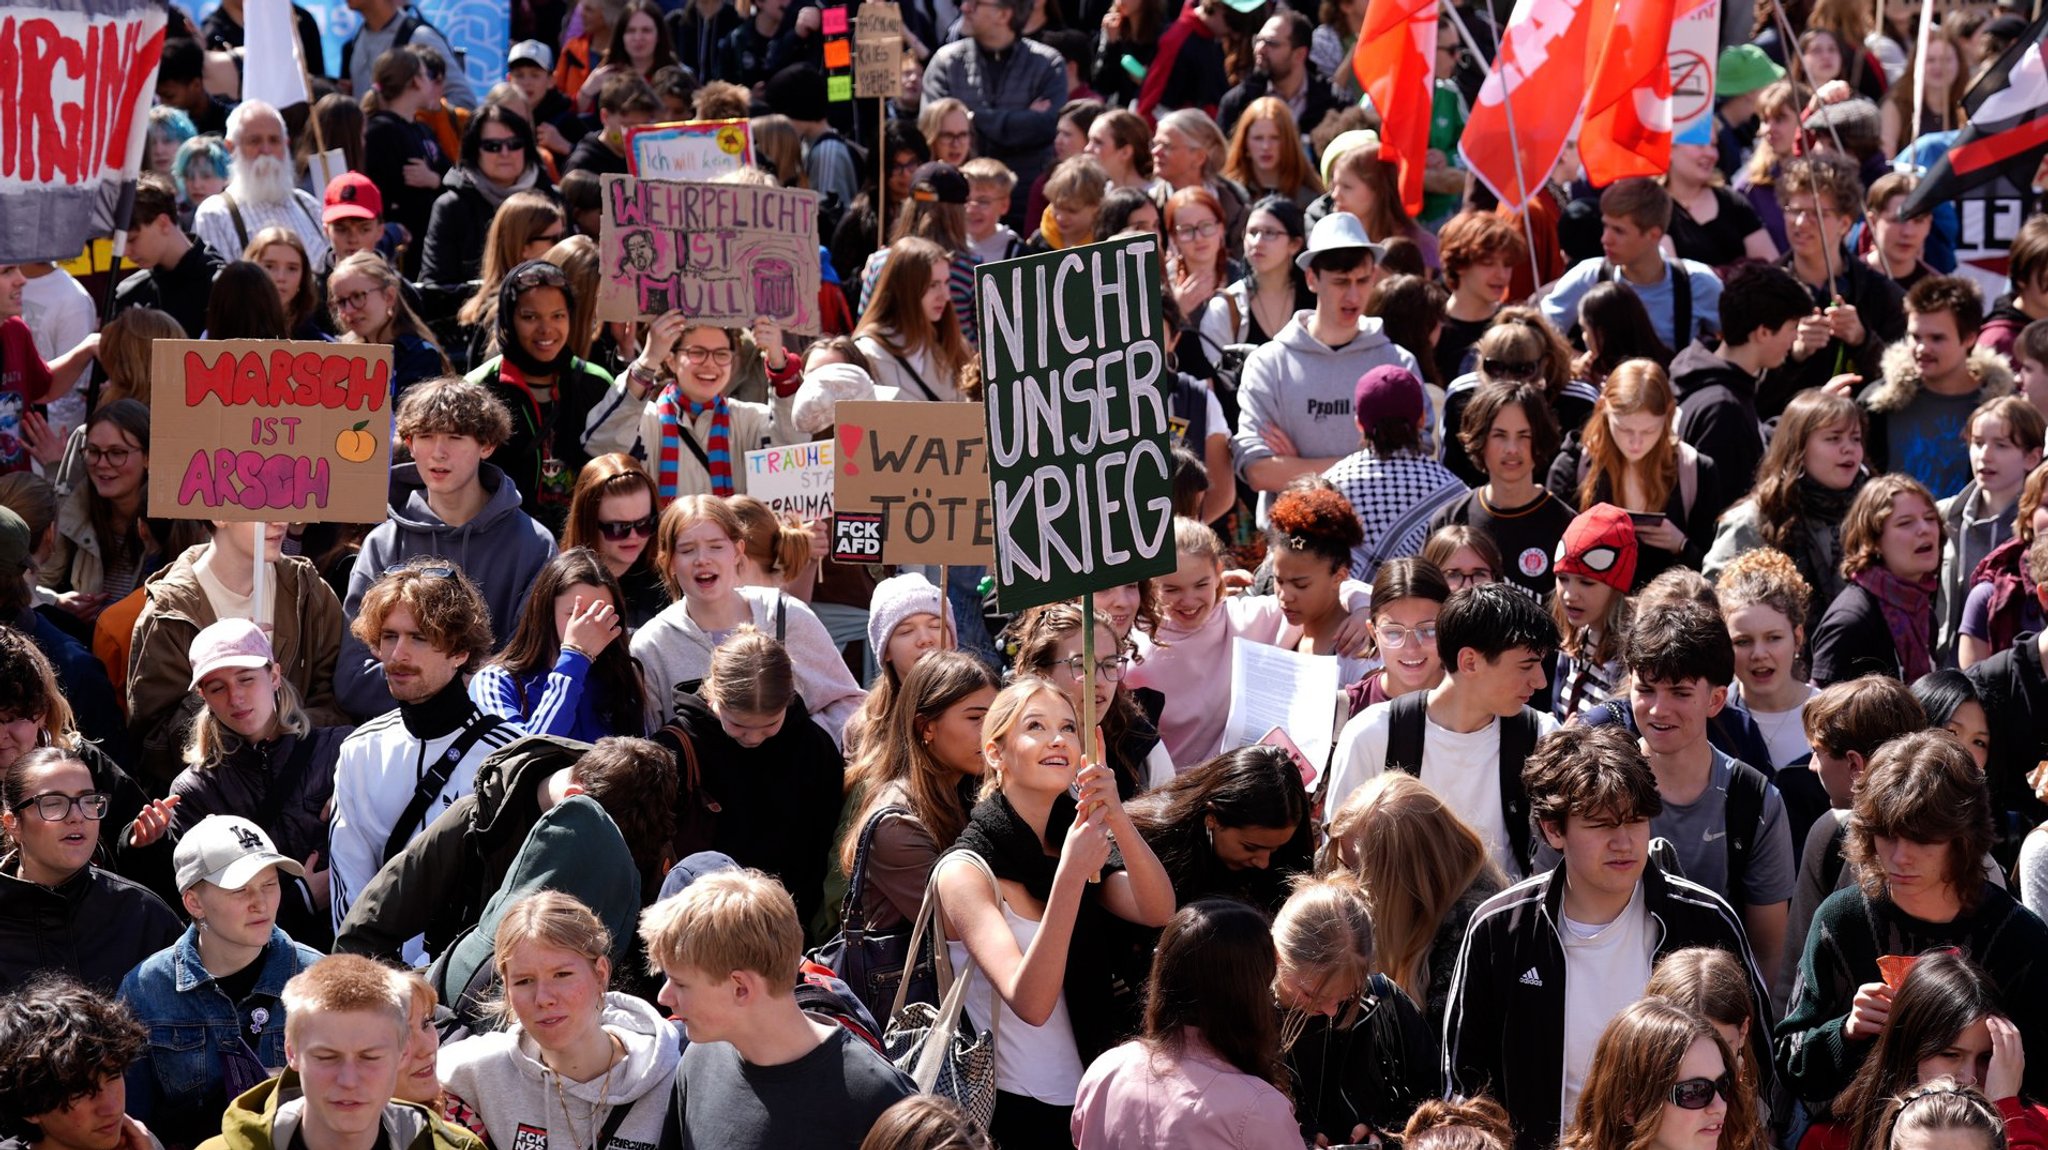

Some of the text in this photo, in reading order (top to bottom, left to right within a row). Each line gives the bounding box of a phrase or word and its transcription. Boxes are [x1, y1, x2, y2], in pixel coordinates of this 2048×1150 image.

[644, 143, 669, 170] Ich
[611, 179, 814, 233] WEHRPFLICHT
[675, 229, 736, 270] IST
[983, 240, 1155, 381] NICHT
[184, 349, 388, 412] MARSCH
[989, 339, 1167, 468] UNSER
[252, 416, 302, 446] IST
[869, 429, 991, 476] WAF
[178, 447, 330, 511] ARSCH
[836, 521, 881, 539] FCK
[995, 439, 1172, 586] KRIEG
[836, 538, 881, 555] AFD
[229, 825, 264, 849] LA
[1519, 977, 1543, 987] adidas
[517, 1130, 546, 1146] FCK
